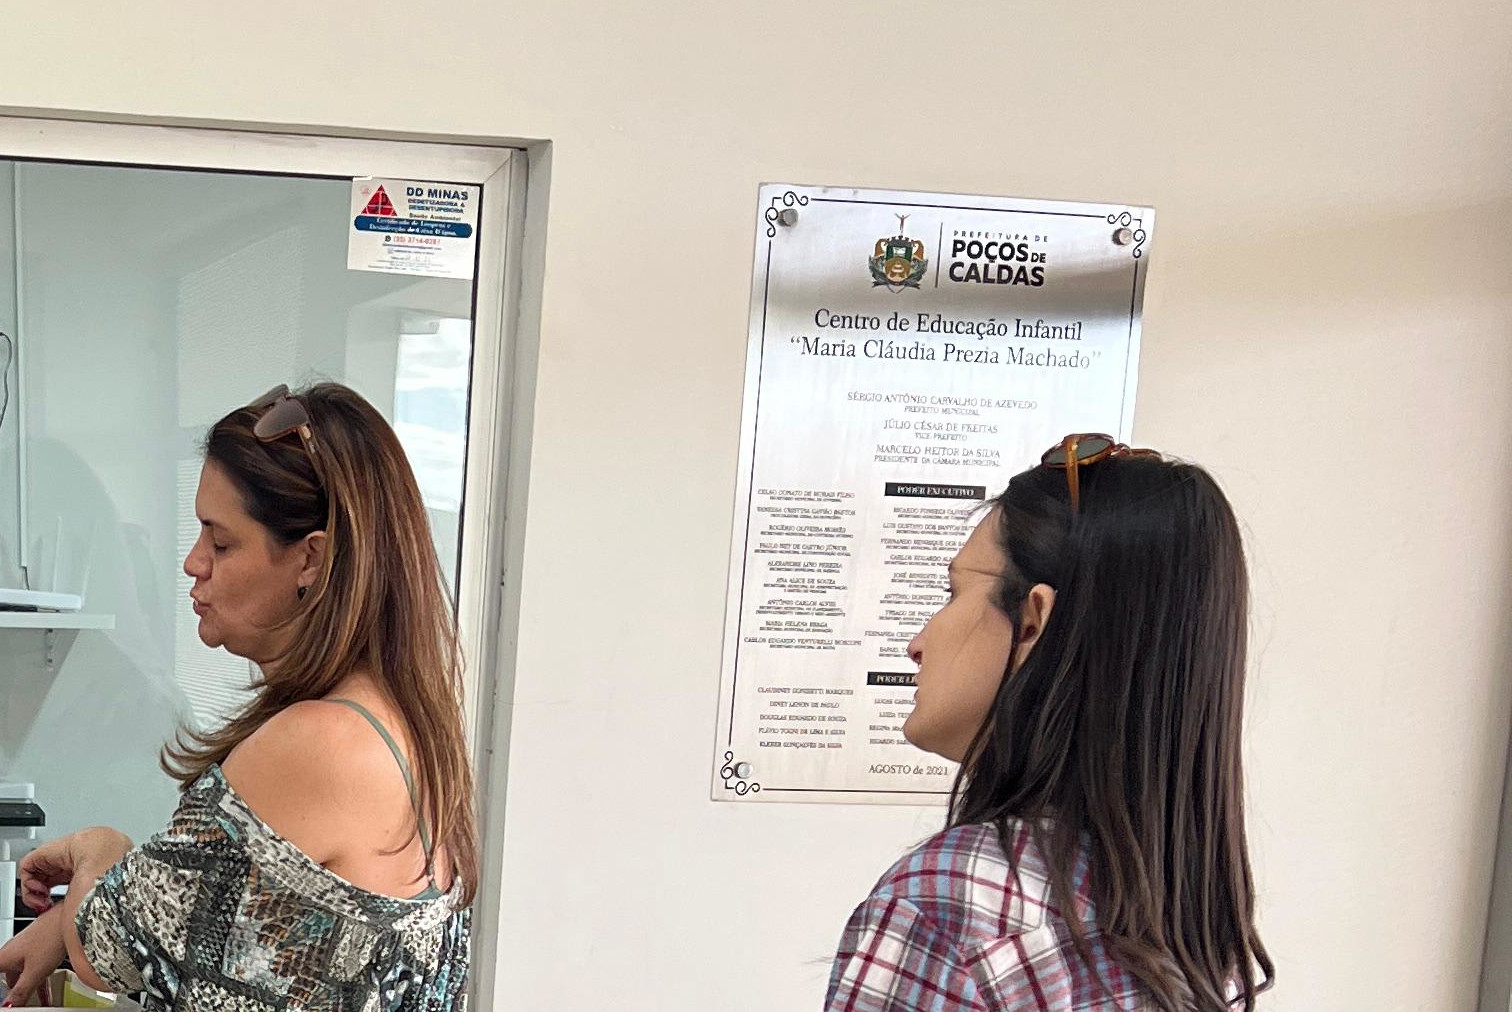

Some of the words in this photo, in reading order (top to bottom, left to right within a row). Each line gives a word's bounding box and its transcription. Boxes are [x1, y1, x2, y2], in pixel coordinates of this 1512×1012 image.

[428, 189, 469, 201] MINAS
[953, 230, 1028, 242] PREFEITURA
[1034, 235, 1048, 243] DE
[951, 240, 1028, 263] POÇOS
[1030, 252, 1047, 263] DE
[949, 262, 1045, 287] CALDAS
[814, 308, 881, 331] Centro
[886, 312, 910, 332] de
[916, 313, 1008, 340] Educação
[1014, 318, 1083, 341] Infantil
[863, 339, 936, 362] Cláudia
[943, 343, 999, 364] Prezia
[847, 391, 882, 402] SÉRGIO
[885, 393, 927, 404] ANTÔNIO
[930, 396, 979, 407] CARVALHO
[980, 398, 992, 407] DE
[994, 399, 1037, 410] AZEVEDO
[883, 418, 911, 430] JÚLIO
[913, 420, 943, 431] CÉSAR
[945, 423, 958, 431] DE
[961, 423, 998, 433] FREITAS
[876, 443, 921, 455] MARCELO
[924, 446, 959, 456] HEITOR
[961, 448, 974, 457] DA
[976, 448, 1000, 458] SILVA
[897, 485, 925, 495] PODER
[926, 487, 974, 496] EXECUTIVO
[868, 764, 911, 775] AGOSTO
[913, 765, 924, 775] de
[926, 766, 949, 775] 2021
